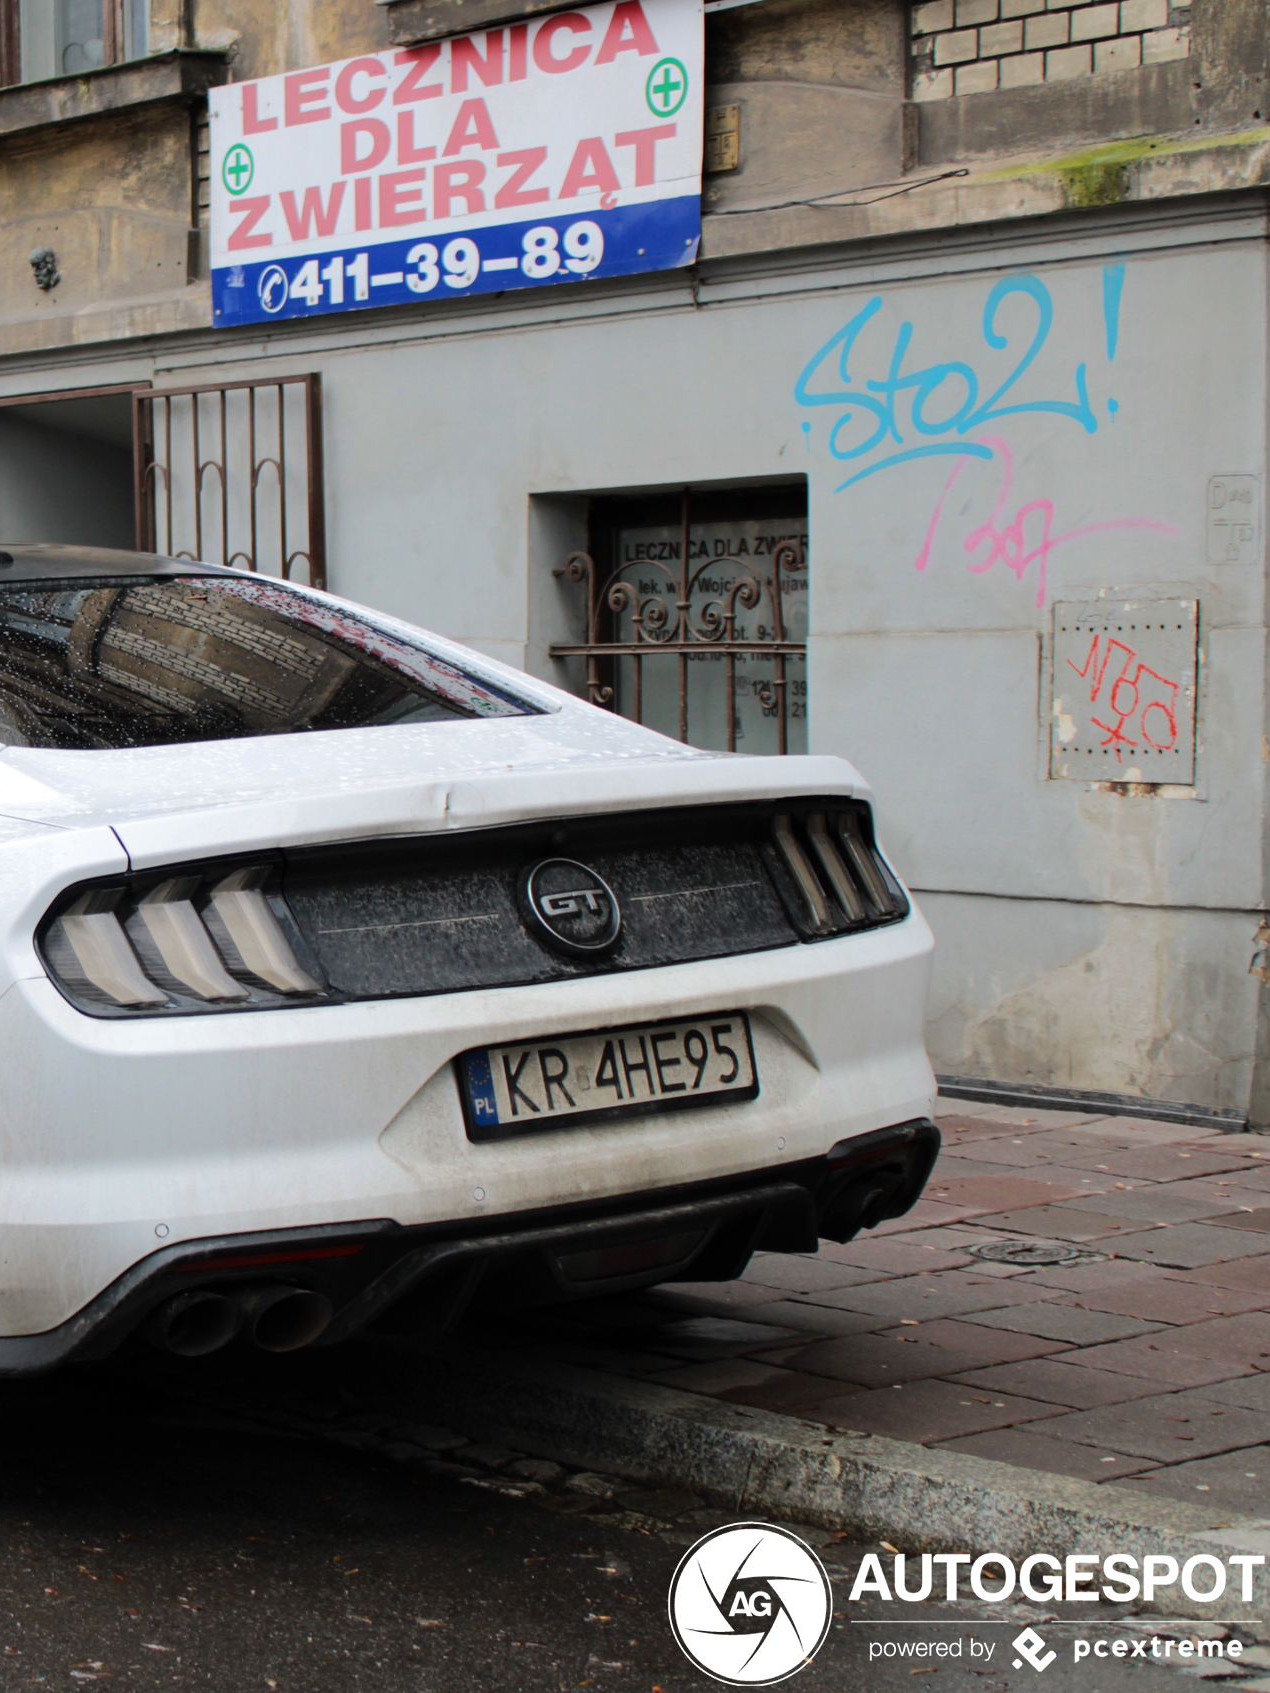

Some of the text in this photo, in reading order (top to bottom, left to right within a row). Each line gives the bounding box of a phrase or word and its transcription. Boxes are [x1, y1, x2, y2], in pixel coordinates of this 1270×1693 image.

[242, 2, 660, 136] LECZNICA
[340, 98, 500, 175] DLA
[228, 123, 677, 251] ZWIERZĄT
[625, 540, 710, 562] LECZNCA
[714, 538, 750, 557] DLA
[540, 889, 604, 916] GT
[474, 1097, 495, 1116] PL
[502, 1024, 740, 1116] KR 4HE95
